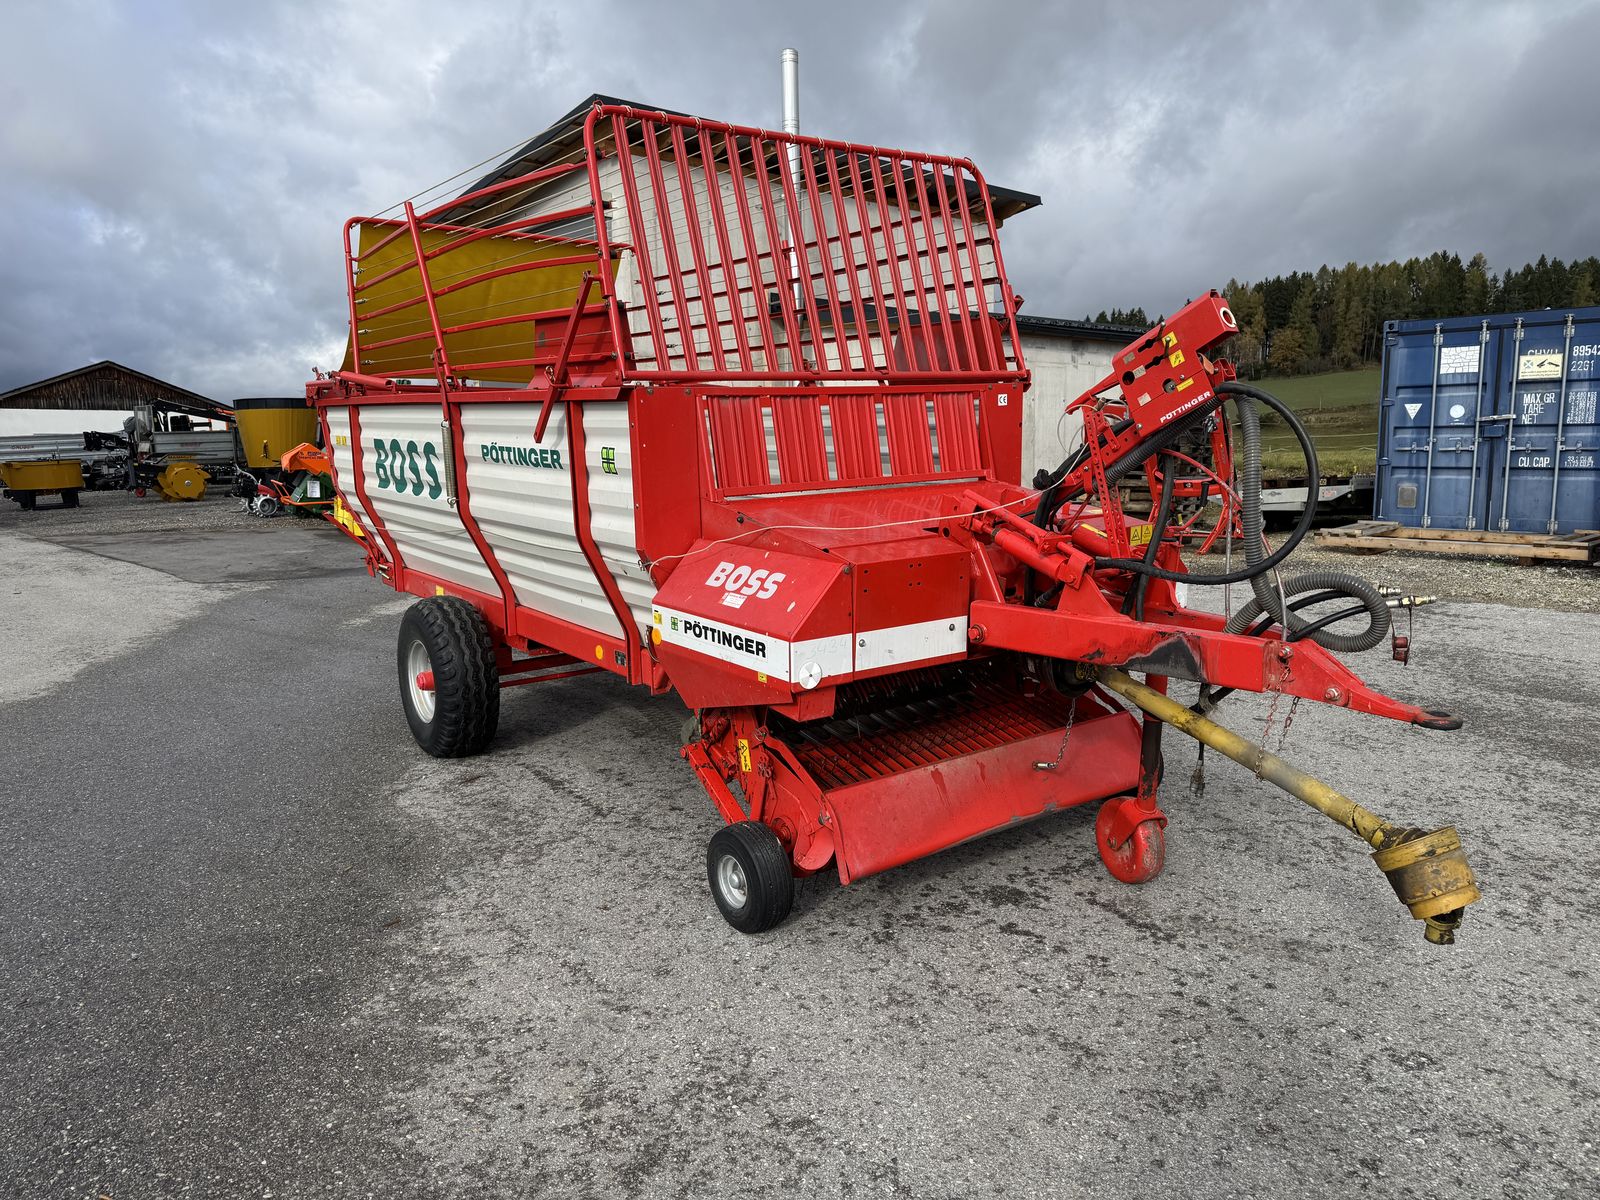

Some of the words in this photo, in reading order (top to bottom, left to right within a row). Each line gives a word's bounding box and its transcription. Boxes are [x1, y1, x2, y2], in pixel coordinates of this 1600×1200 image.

[1570, 359, 1595, 372] 22G1
[1521, 413, 1539, 424] NET
[1523, 403, 1545, 414] TARE
[481, 441, 564, 470] PÖTTINGER
[1518, 456, 1530, 468] CU.
[1533, 456, 1551, 468] CAP.
[373, 438, 443, 500] BOSS
[705, 561, 786, 600] BOSS
[683, 620, 767, 658] PÖTTINGER
